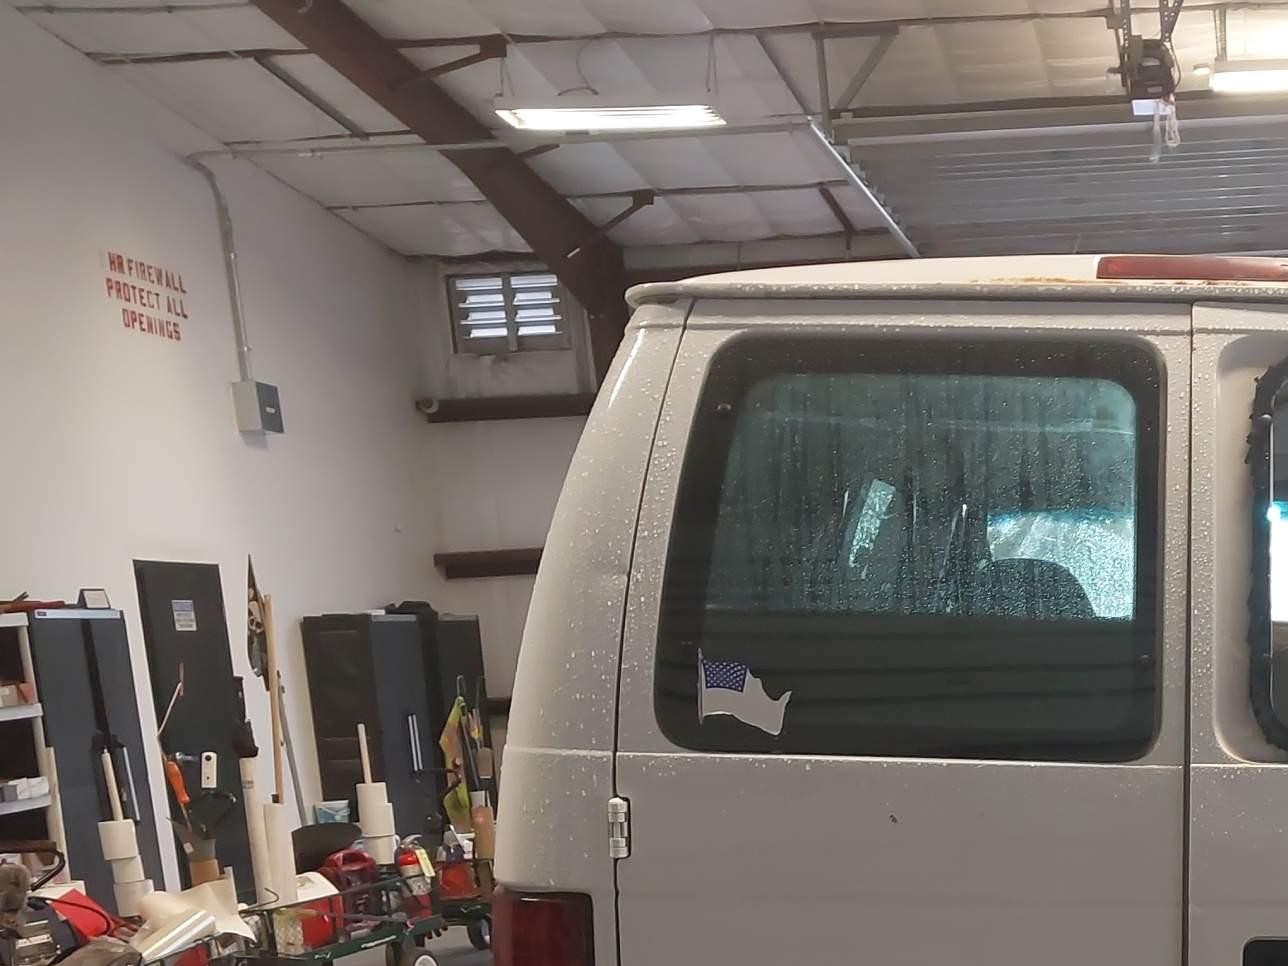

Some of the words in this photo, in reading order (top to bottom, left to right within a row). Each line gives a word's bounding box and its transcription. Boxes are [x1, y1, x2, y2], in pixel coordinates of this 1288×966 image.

[126, 257, 187, 294] FIREWALL
[106, 277, 161, 311] PROTECT
[166, 295, 188, 319] ALL
[122, 307, 182, 341] OPENINGS
